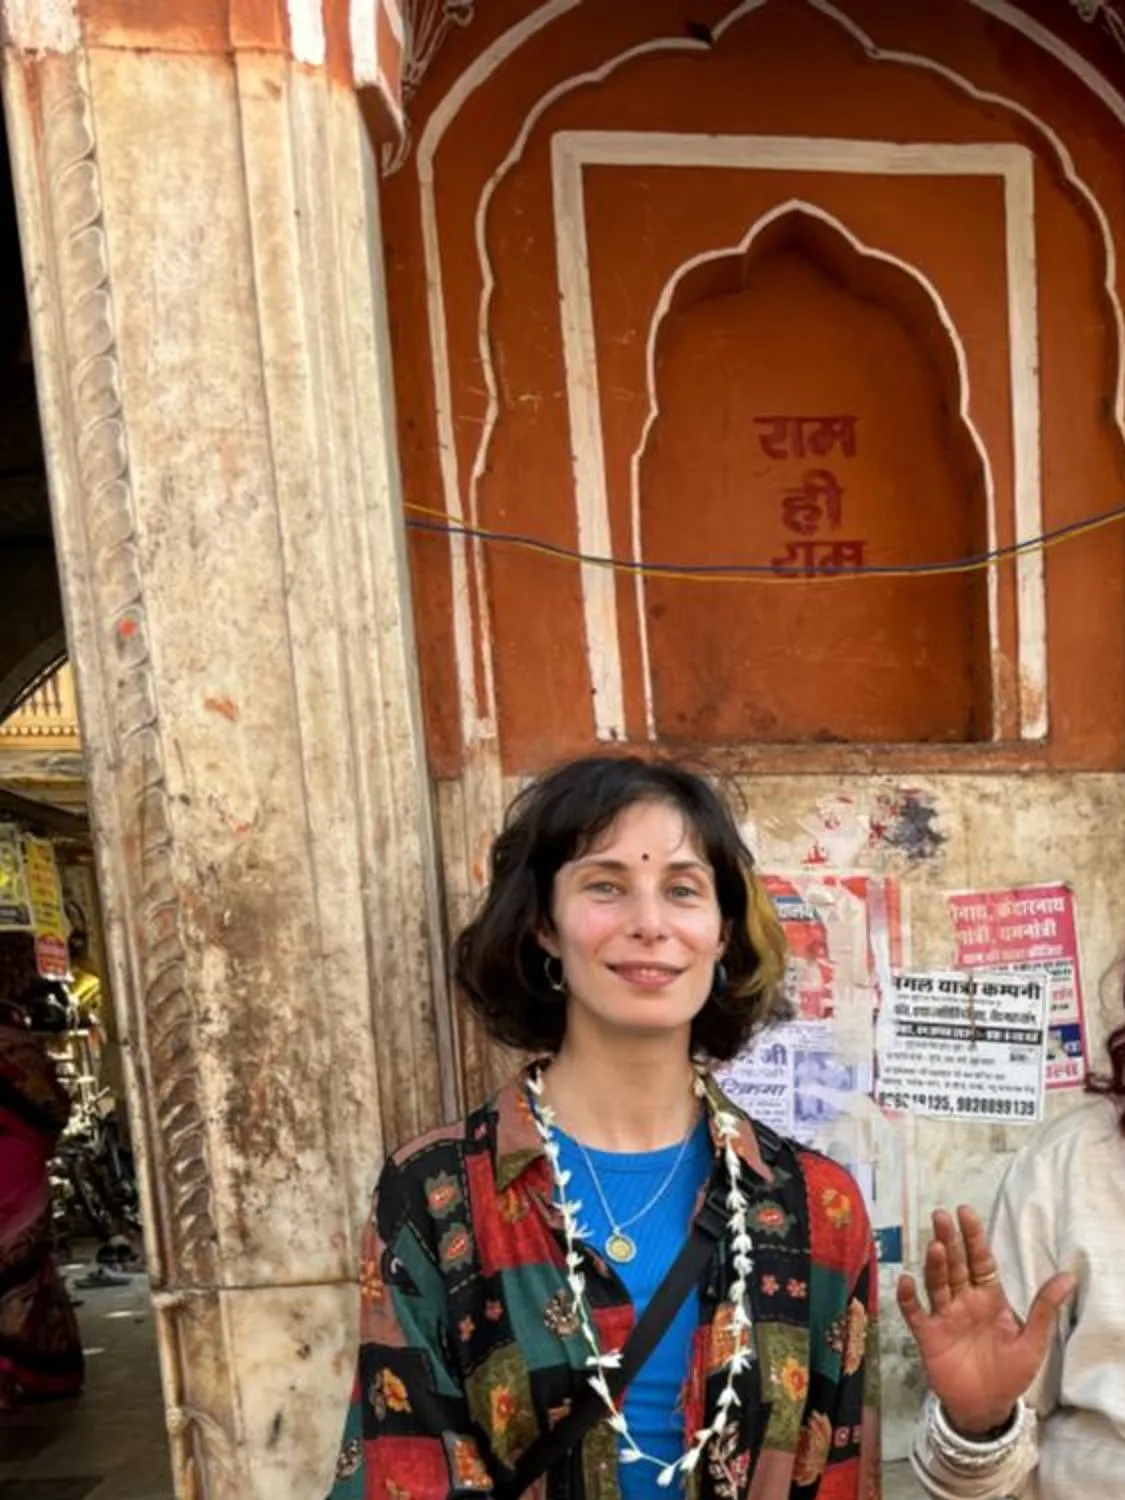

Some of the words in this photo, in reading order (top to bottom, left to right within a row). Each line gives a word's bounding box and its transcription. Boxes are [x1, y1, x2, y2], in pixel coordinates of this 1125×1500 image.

[753, 415, 858, 460] राम
[770, 539, 866, 578] राम
[938, 979, 978, 996] यात्रा
[982, 980, 1041, 1000] कम्पनी
